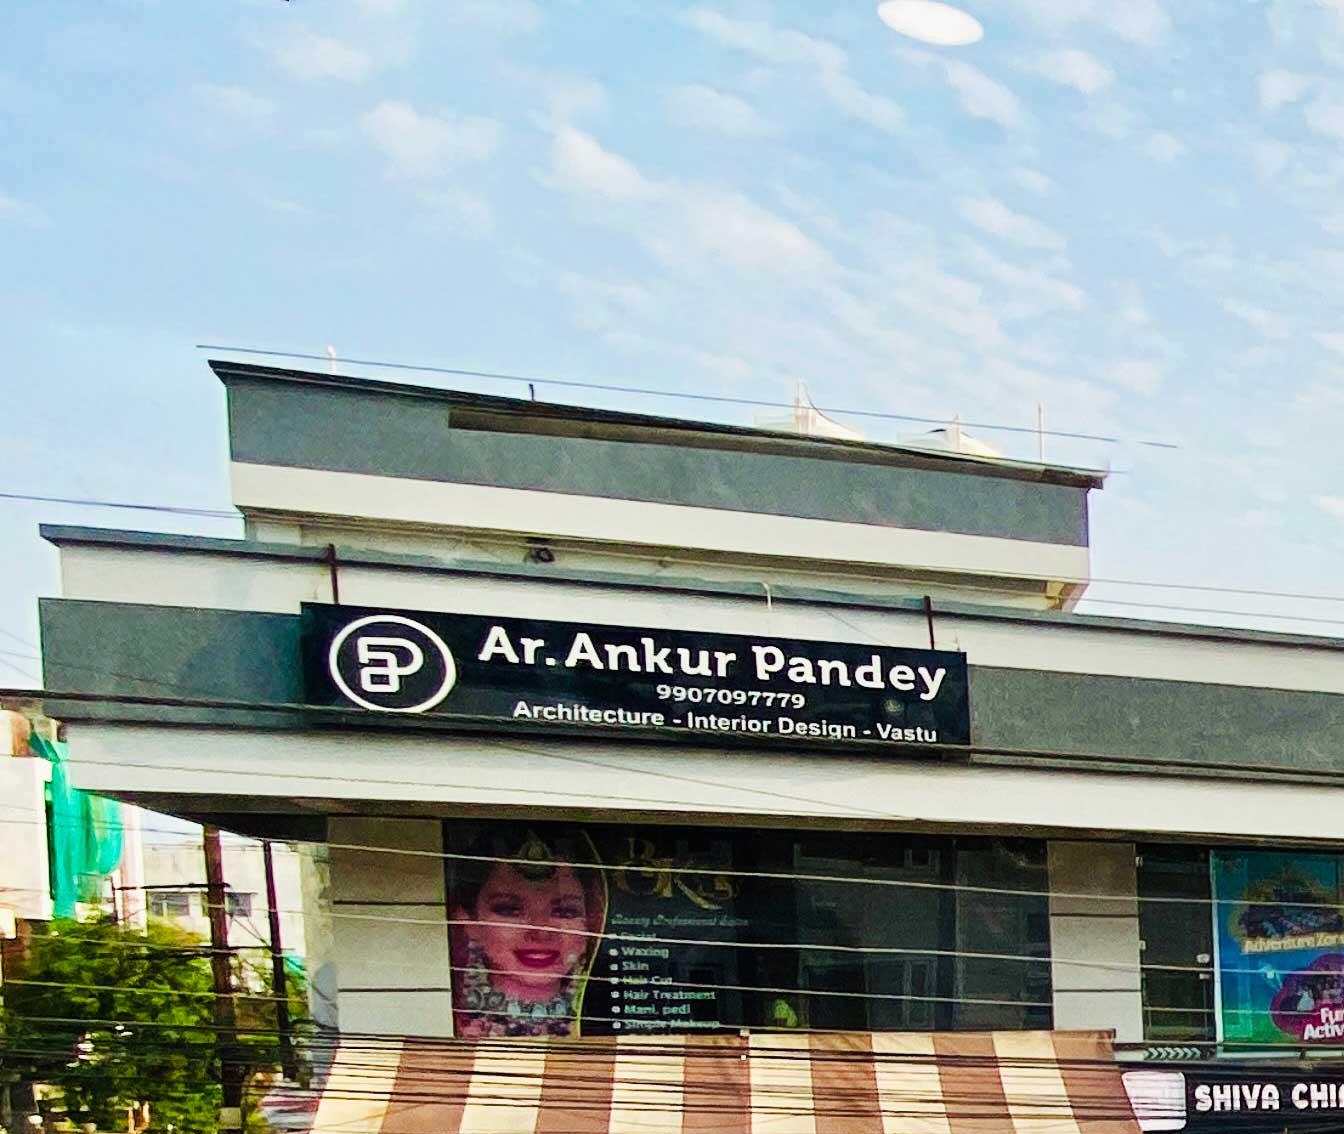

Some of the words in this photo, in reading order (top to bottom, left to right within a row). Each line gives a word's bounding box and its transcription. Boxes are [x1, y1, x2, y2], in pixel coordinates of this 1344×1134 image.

[751, 645, 947, 701] Pandey
[655, 683, 807, 710] 9907097779
[512, 700, 665, 726] Architecture
[687, 711, 772, 734] Interior
[778, 717, 857, 740] Design
[875, 722, 938, 743] Vastu
[621, 946, 669, 959] Waxing
[622, 961, 649, 971] Skin
[623, 990, 648, 1000] Hair
[653, 989, 716, 1000] Treatment
[1194, 1083, 1280, 1112] SHIVA
